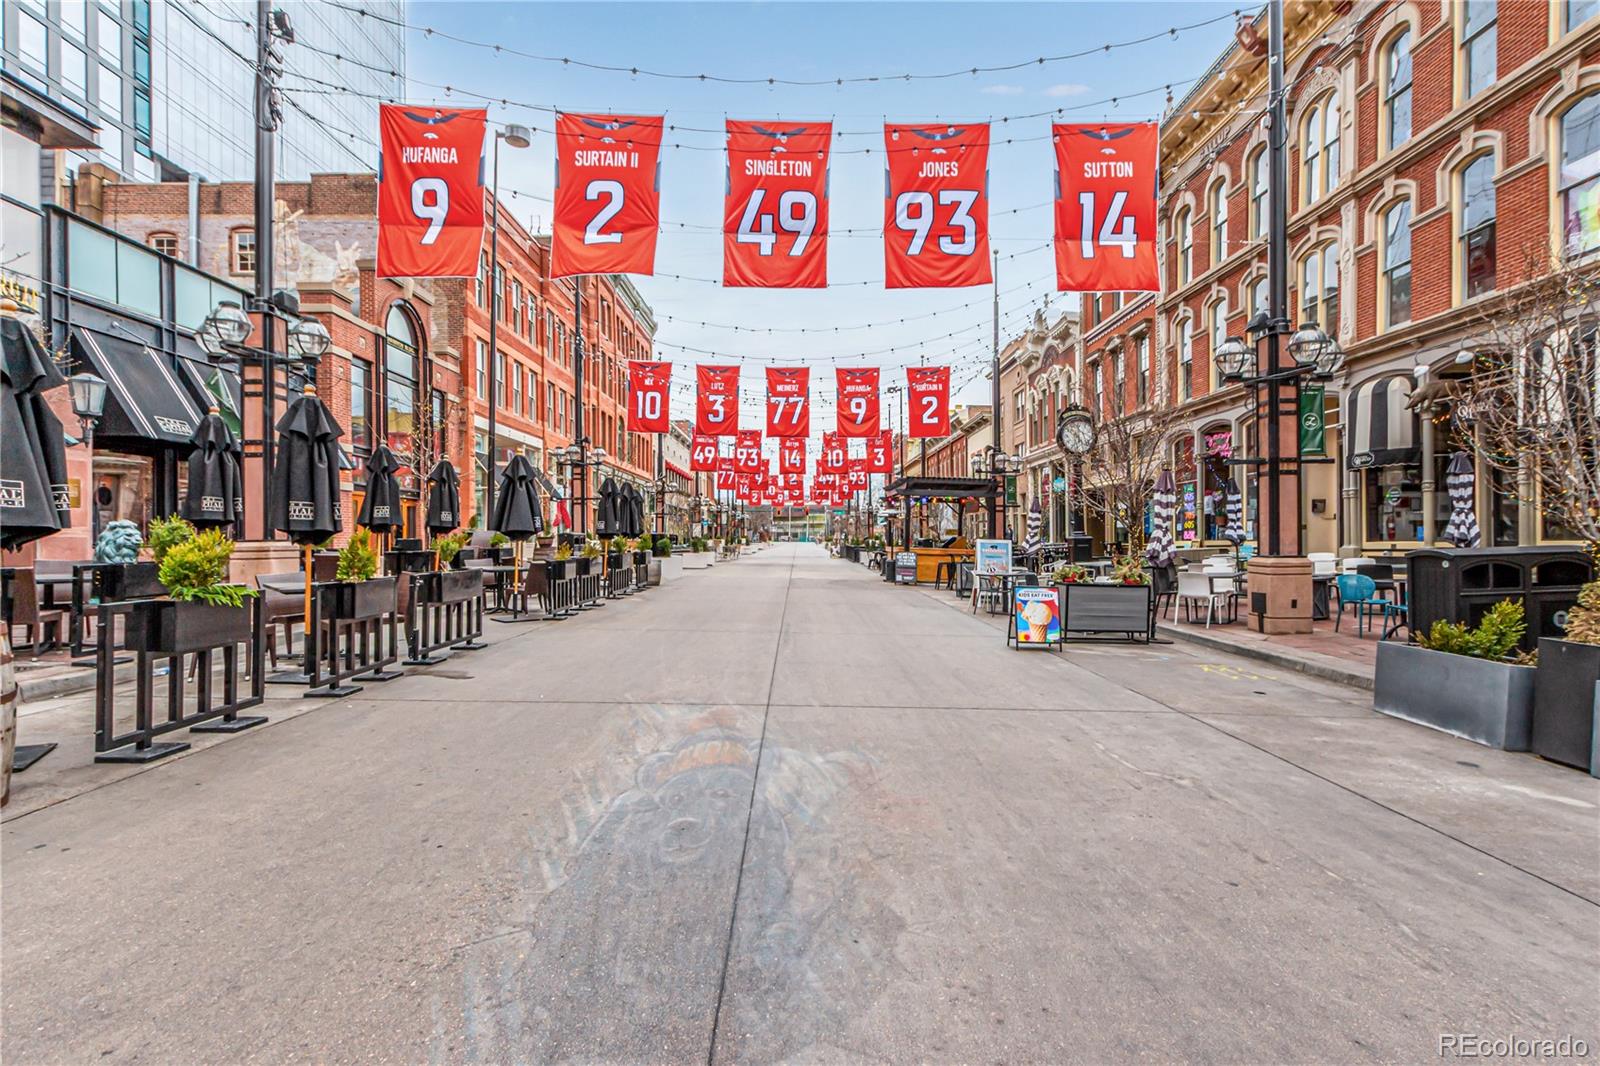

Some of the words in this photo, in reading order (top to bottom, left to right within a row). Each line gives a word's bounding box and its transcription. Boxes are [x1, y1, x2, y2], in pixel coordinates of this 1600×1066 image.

[402, 145, 458, 165] HUFANGA
[575, 150, 627, 168] SURTAIN
[630, 152, 639, 168] II
[745, 159, 812, 178] SINGLETON
[918, 161, 959, 178] JONES
[1084, 161, 1134, 178] SUTTON
[411, 177, 449, 245] 9
[584, 179, 625, 245] 2
[736, 189, 817, 257] 49
[895, 190, 980, 257] 93
[1079, 191, 1138, 259] 14
[710, 382, 724, 390] LUTZ
[776, 384, 799, 392] MEINERZ
[636, 391, 662, 420] 10
[708, 394, 725, 423] 3
[770, 397, 805, 424] 77
[851, 397, 867, 425] 9
[921, 396, 939, 424] 2
[693, 446, 715, 464] 49
[736, 448, 758, 467] 93
[784, 449, 801, 467] 14
[827, 449, 844, 467] 10
[873, 448, 885, 466] 3
[719, 471, 735, 484] 77
[789, 474, 798, 485] 2
[849, 471, 866, 485] 93
[740, 484, 749, 495] 14
[752, 493, 758, 503] 2
